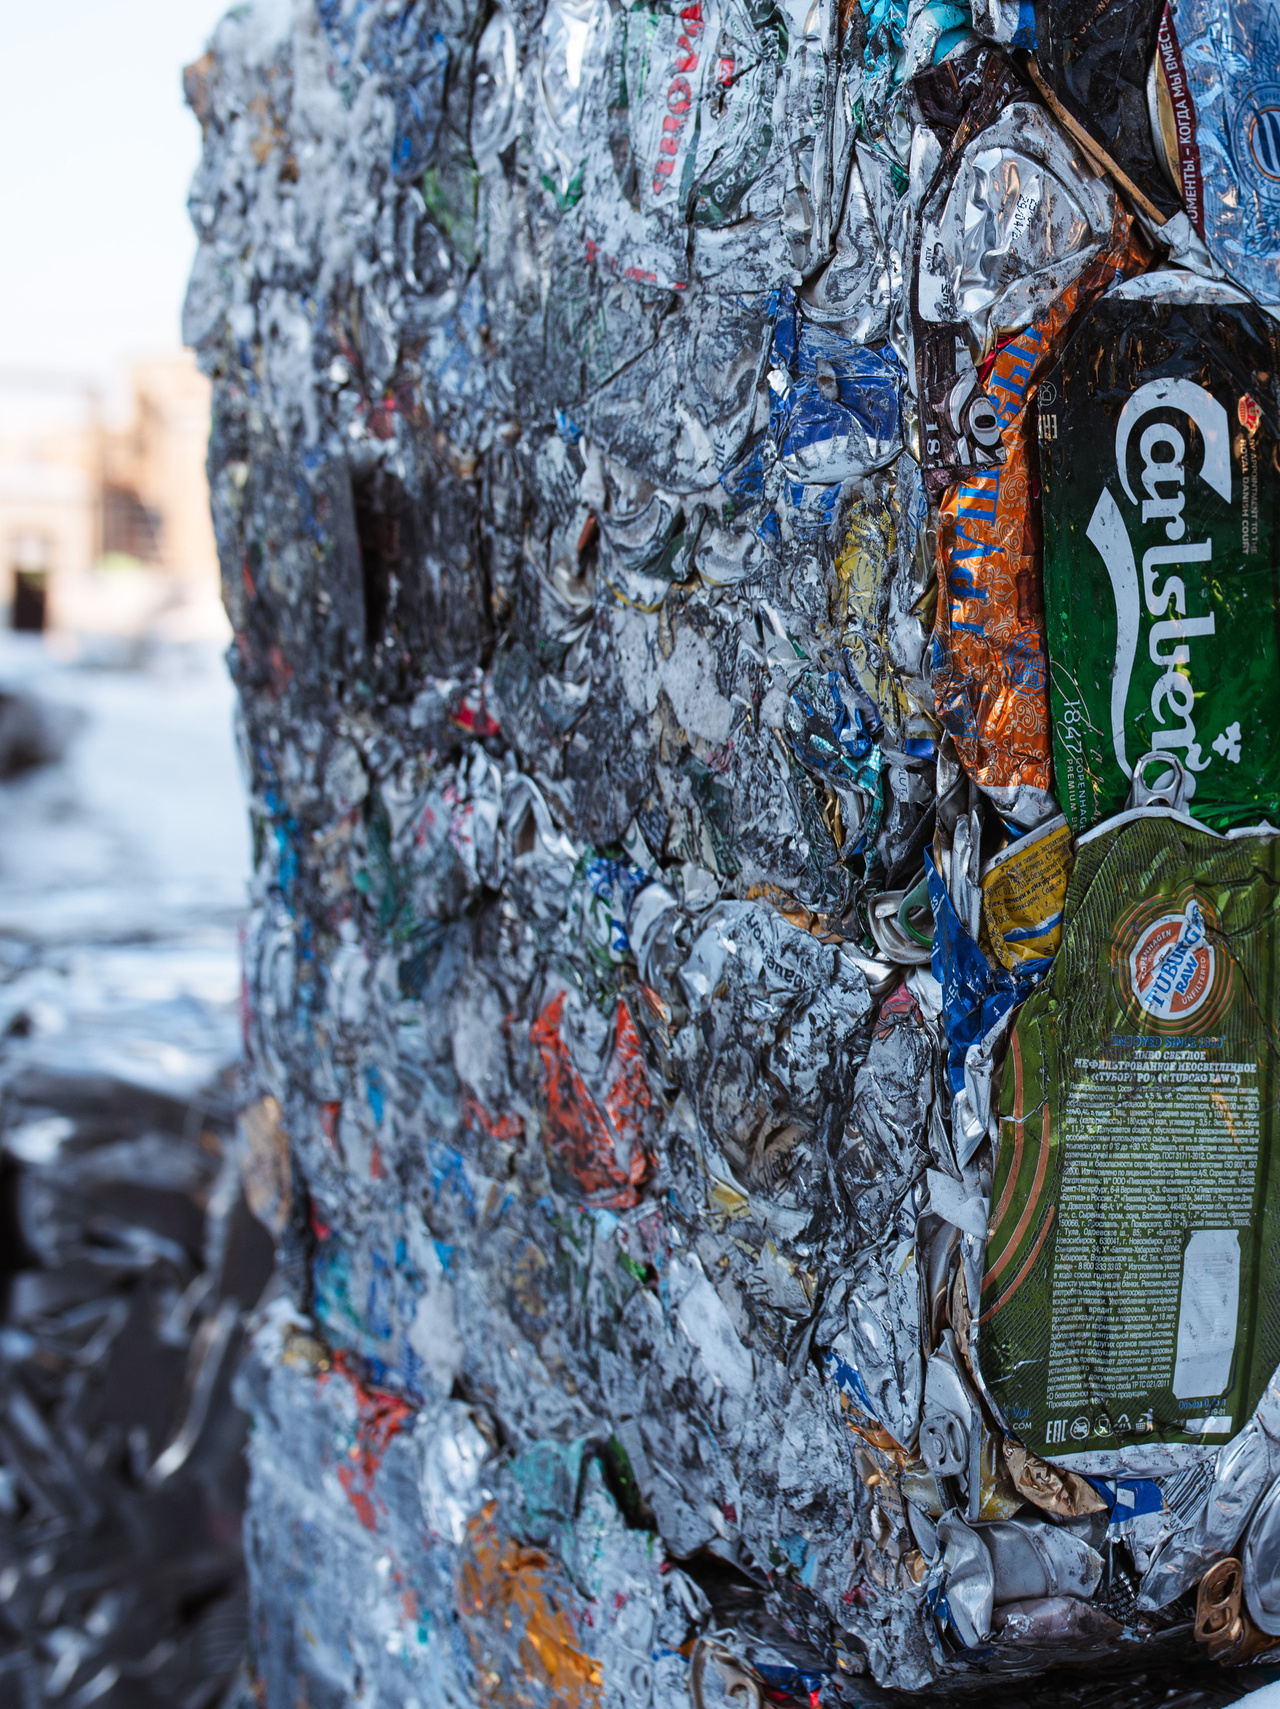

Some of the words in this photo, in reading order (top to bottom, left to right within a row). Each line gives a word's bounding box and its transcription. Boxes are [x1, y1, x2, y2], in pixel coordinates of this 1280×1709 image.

[1169, 72, 1187, 98] МЫ
[1174, 99, 1193, 145] КОГДА
[1240, 439, 1249, 474] ROYAL
[1241, 476, 1250, 517] DANISH
[1249, 453, 1258, 519] APPOINTMENT
[1241, 519, 1249, 556] COURT
[1250, 522, 1258, 534] TO
[1250, 536, 1258, 555] THE
[1066, 758, 1077, 812] PREMIUM
[1175, 955, 1197, 995] RAW
[1182, 956, 1206, 1005] UNFILTERED
[1111, 1035, 1161, 1048] ENJOYED
[1165, 1037, 1196, 1048] SINCE
[1134, 1051, 1161, 1060] ПИВО
[1163, 1051, 1206, 1061] СВЕТЛОЕ
[1074, 1058, 1176, 1071] НЕФИЛЬТРОВАННОЕ
[1177, 1062, 1256, 1073] НЕОСВЕТЛЕННОЕ
